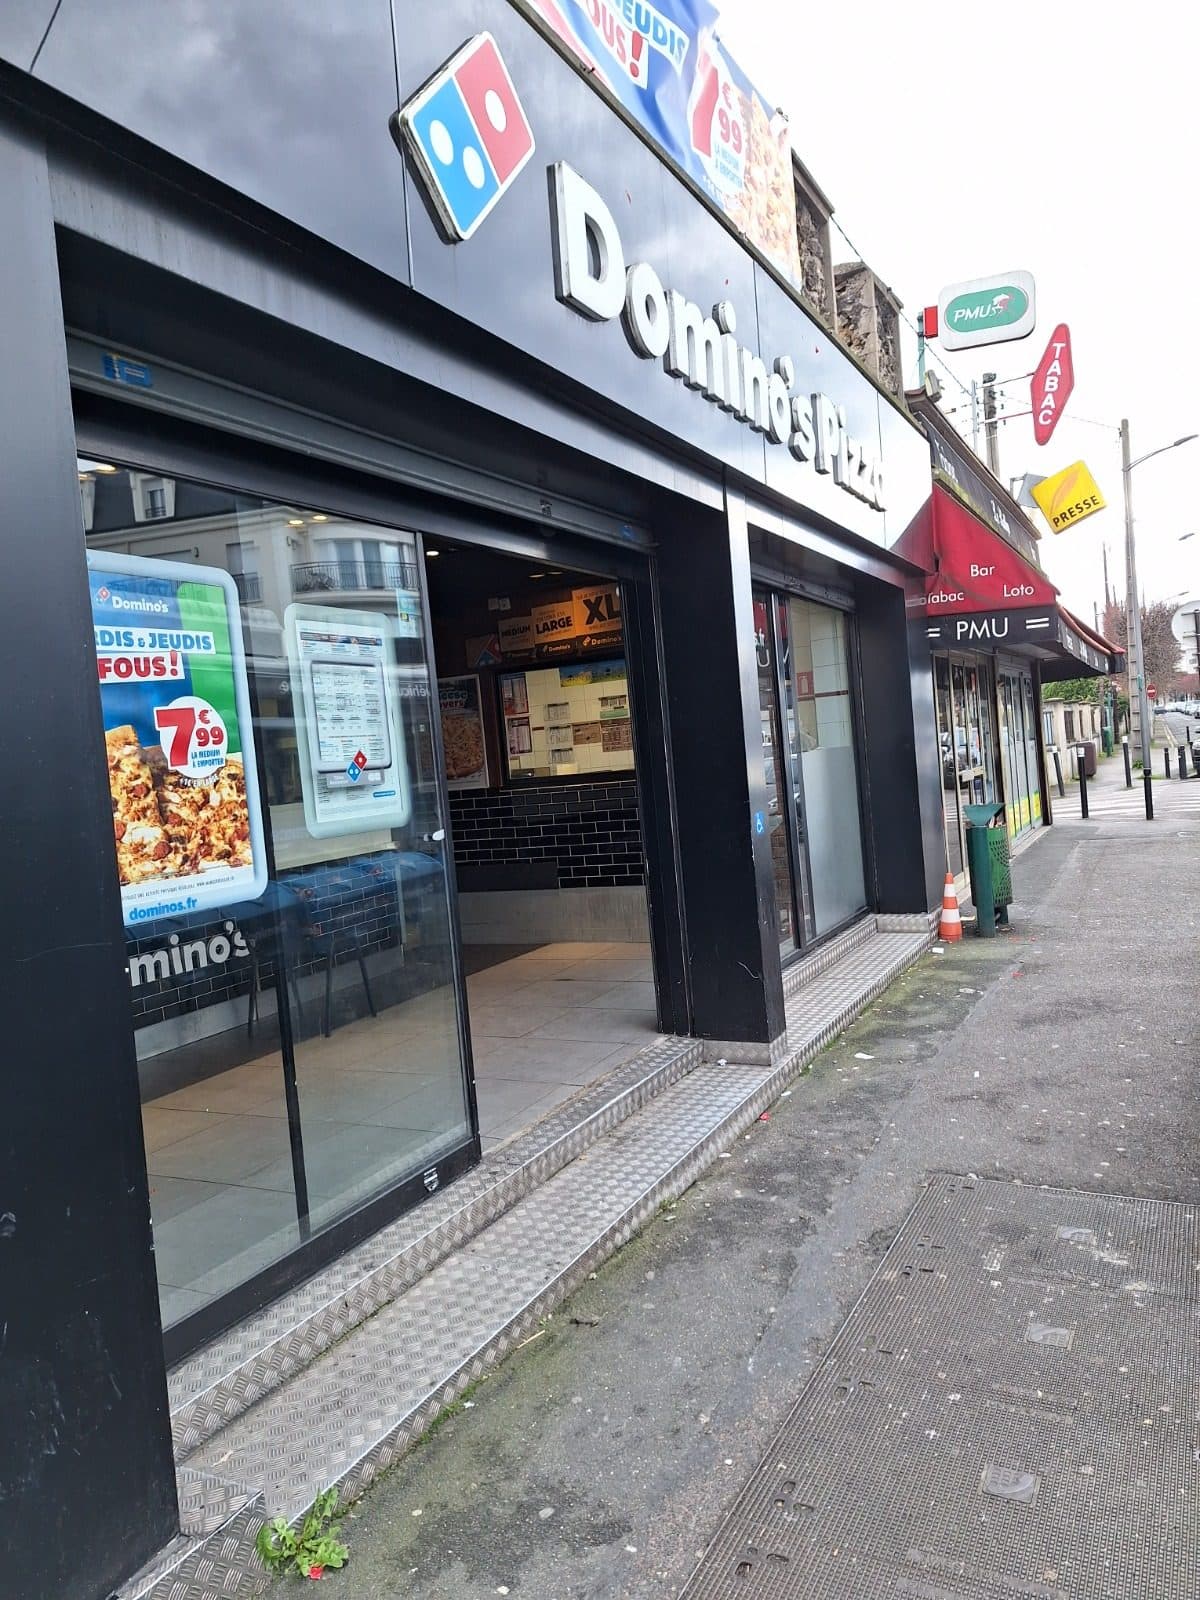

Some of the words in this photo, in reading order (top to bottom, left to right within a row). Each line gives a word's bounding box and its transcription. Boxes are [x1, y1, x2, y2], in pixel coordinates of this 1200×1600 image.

[615, 0, 687, 65] EUDIS
[546, 160, 815, 463] Domino's
[953, 303, 992, 323] PMU
[1038, 343, 1065, 426] TABAC
[1052, 495, 1100, 528] PRESSE
[970, 564, 996, 578] Bar
[1003, 583, 1035, 598] Loto
[111, 596, 169, 614] Domino's
[582, 592, 621, 626] XL
[535, 615, 573, 635] LARGE
[956, 617, 1009, 640] PMU
[148, 632, 212, 650] JEUDIS
[195, 726, 225, 747] 99
[129, 897, 198, 921] dominos.fr
